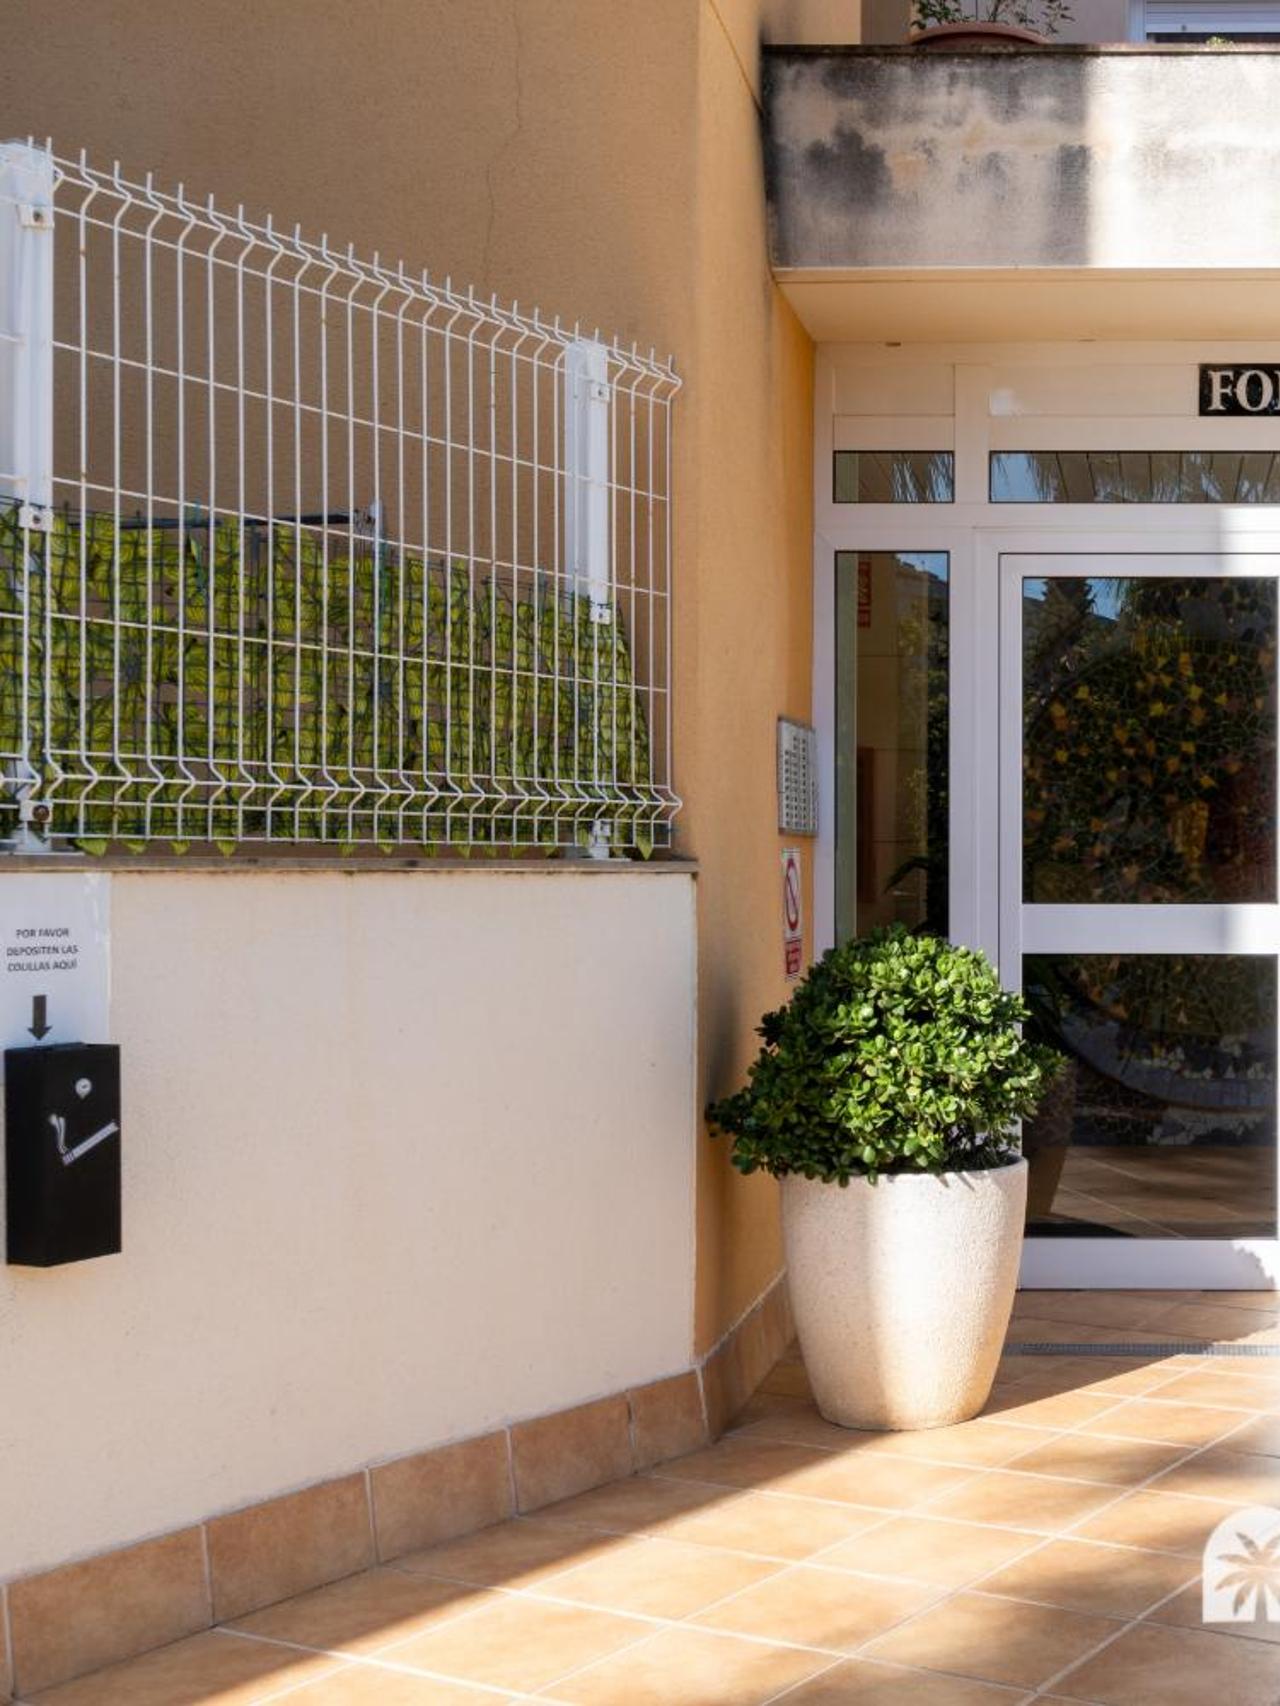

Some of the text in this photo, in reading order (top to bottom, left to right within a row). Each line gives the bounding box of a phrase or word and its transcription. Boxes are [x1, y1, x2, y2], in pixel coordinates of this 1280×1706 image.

[16, 927, 69, 939] POR FAVOR
[6, 944, 79, 956] DEPOSITEN LAS
[7, 961, 51, 972] COLILLAS
